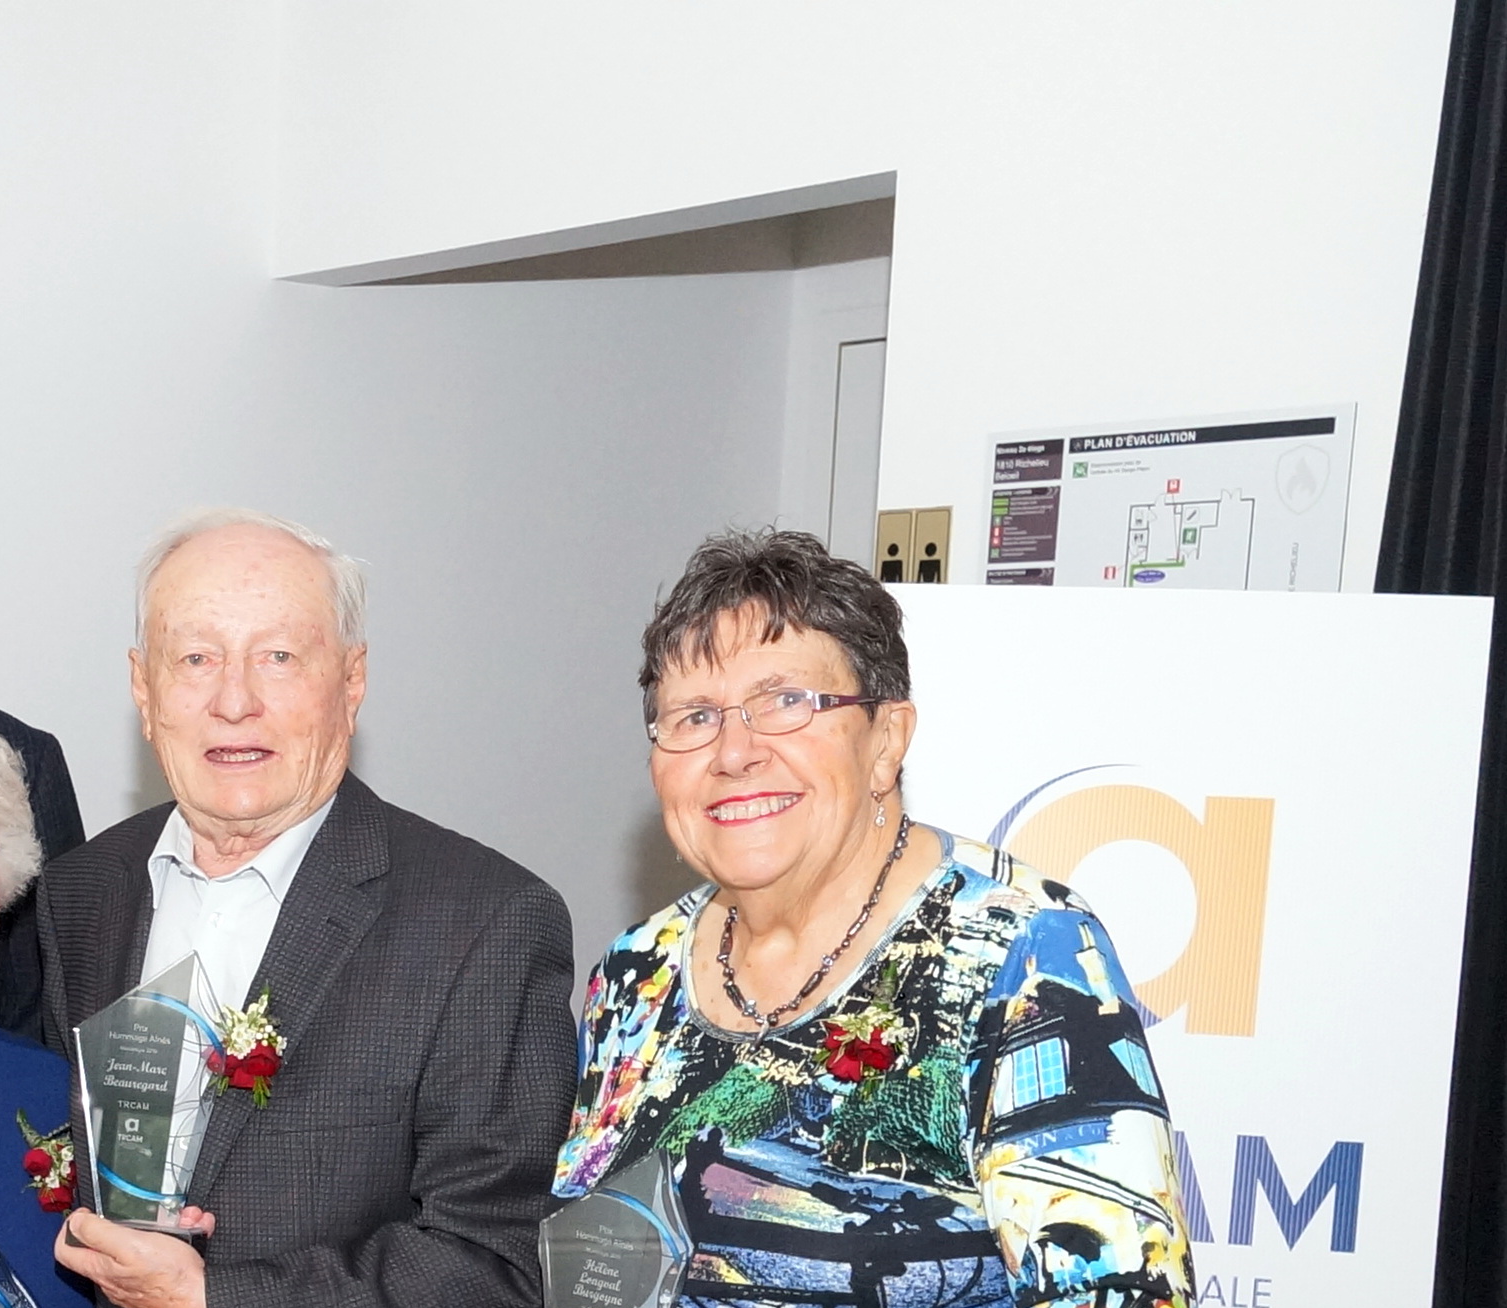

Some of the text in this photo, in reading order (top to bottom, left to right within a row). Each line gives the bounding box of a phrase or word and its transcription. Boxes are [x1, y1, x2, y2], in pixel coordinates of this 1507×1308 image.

[1084, 431, 1197, 450] PLAN D'ÉVACUATION
[106, 1058, 168, 1076] Jean-Marc
[103, 1075, 169, 1093] Beauregard
